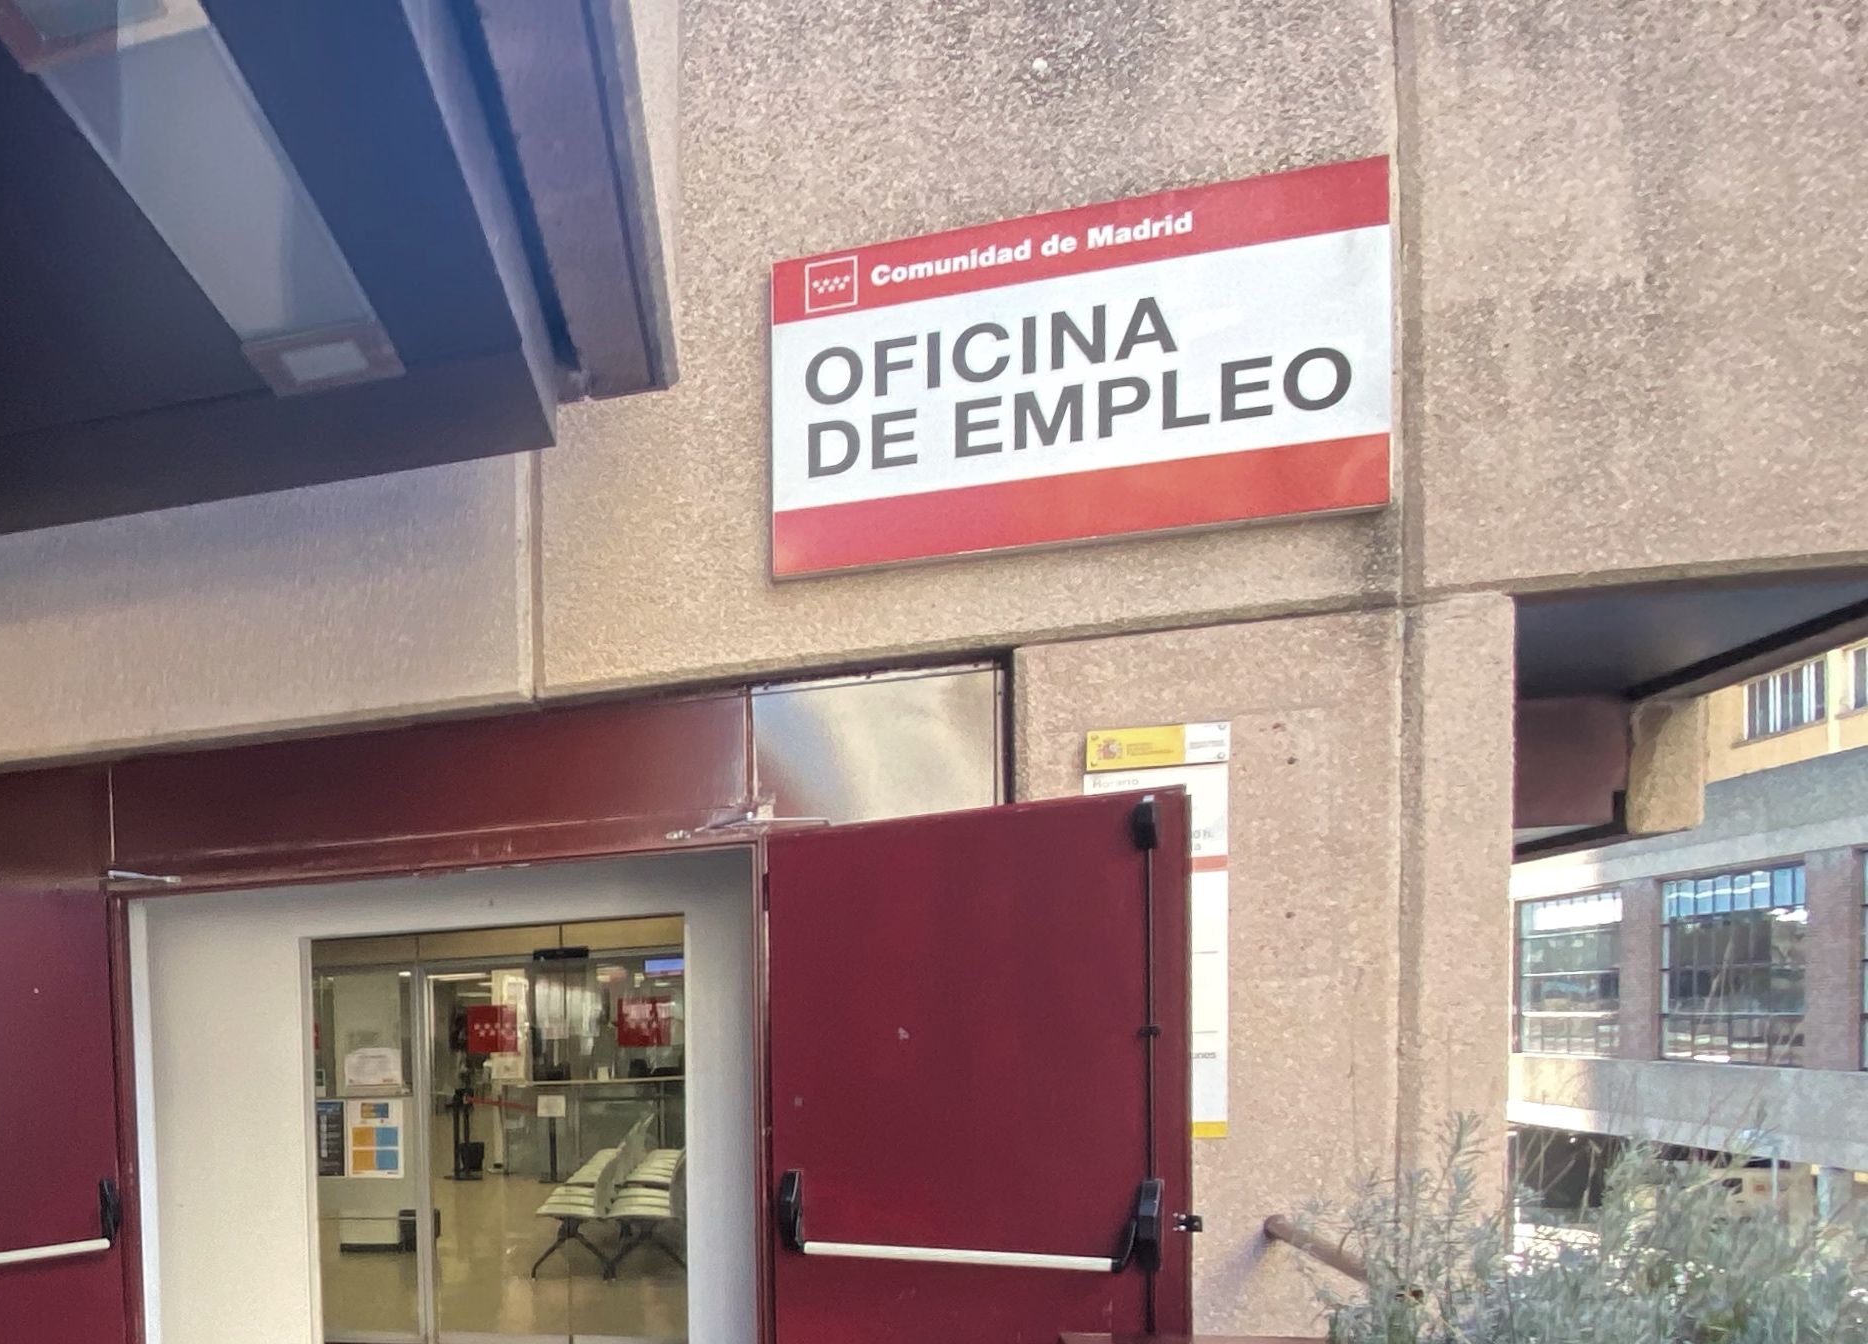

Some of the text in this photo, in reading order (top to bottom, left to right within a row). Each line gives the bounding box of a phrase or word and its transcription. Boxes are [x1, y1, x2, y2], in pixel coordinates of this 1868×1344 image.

[870, 211, 1193, 286] Comunidad de Madrid
[805, 296, 1177, 405] OFICINA
[807, 346, 1352, 478] DE EMPLEO
